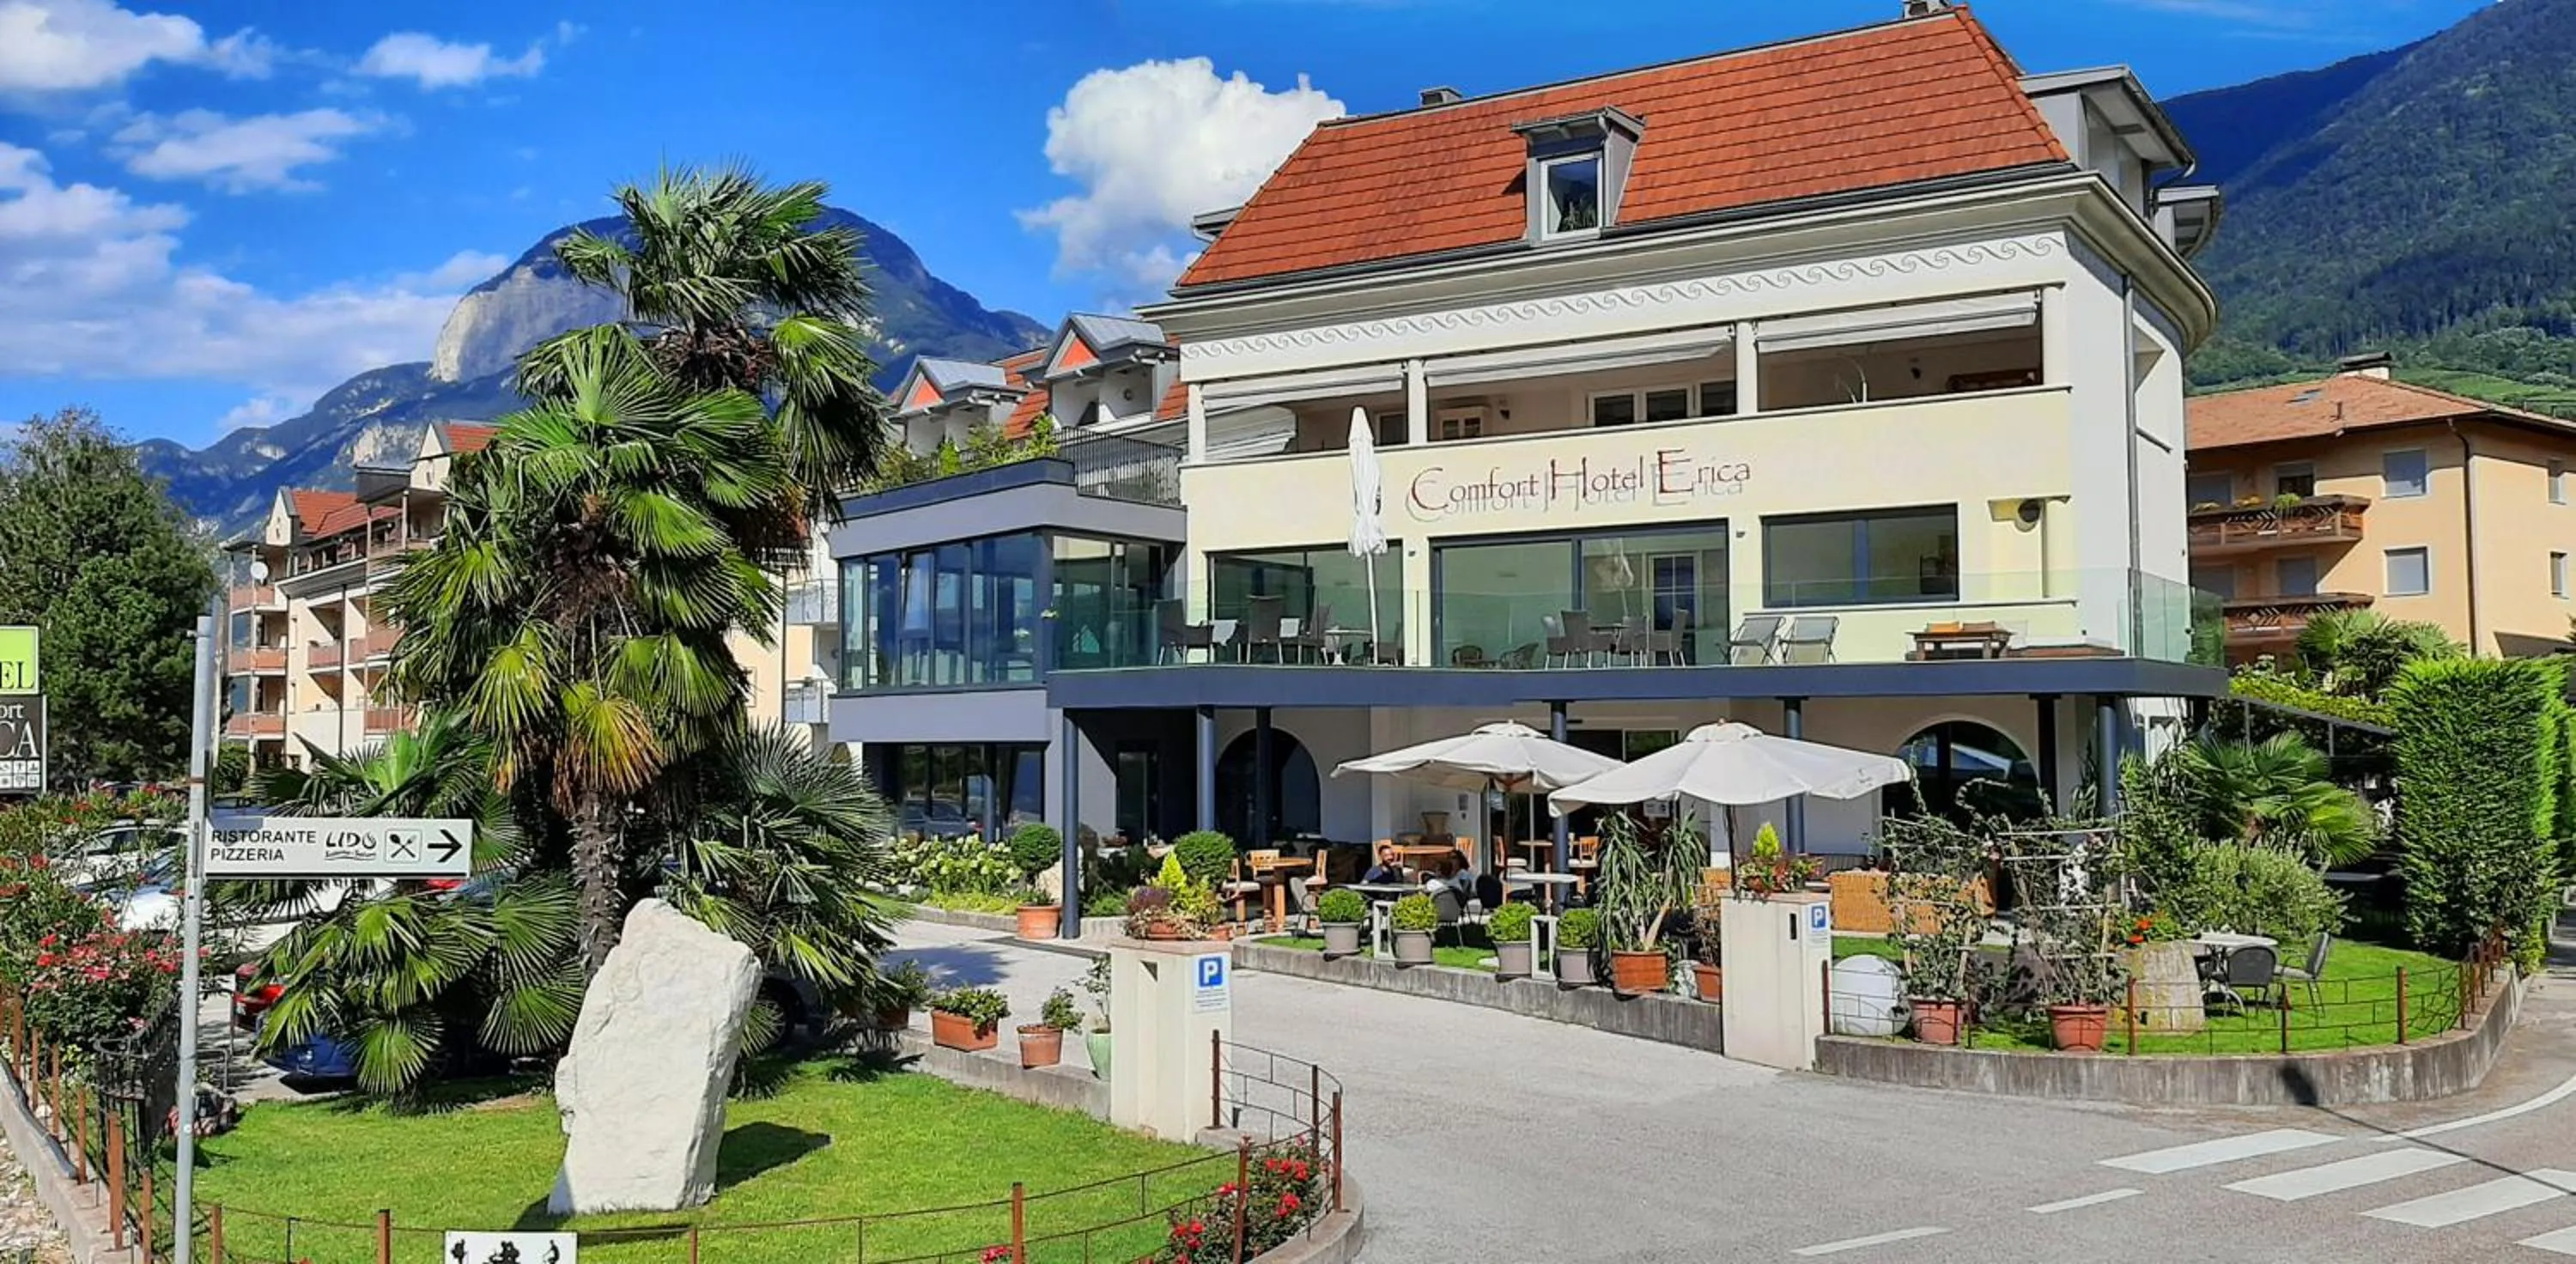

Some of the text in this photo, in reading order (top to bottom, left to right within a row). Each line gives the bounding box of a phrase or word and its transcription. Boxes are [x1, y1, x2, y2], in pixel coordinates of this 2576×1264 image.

[1412, 448, 1752, 510] Comfort Hotel Erica
[211, 830, 316, 843] RISTORANTE
[325, 830, 377, 849] LIDO
[210, 848, 284, 861] PIZZERIA
[1814, 908, 1823, 926] P
[1203, 961, 1218, 984] P
